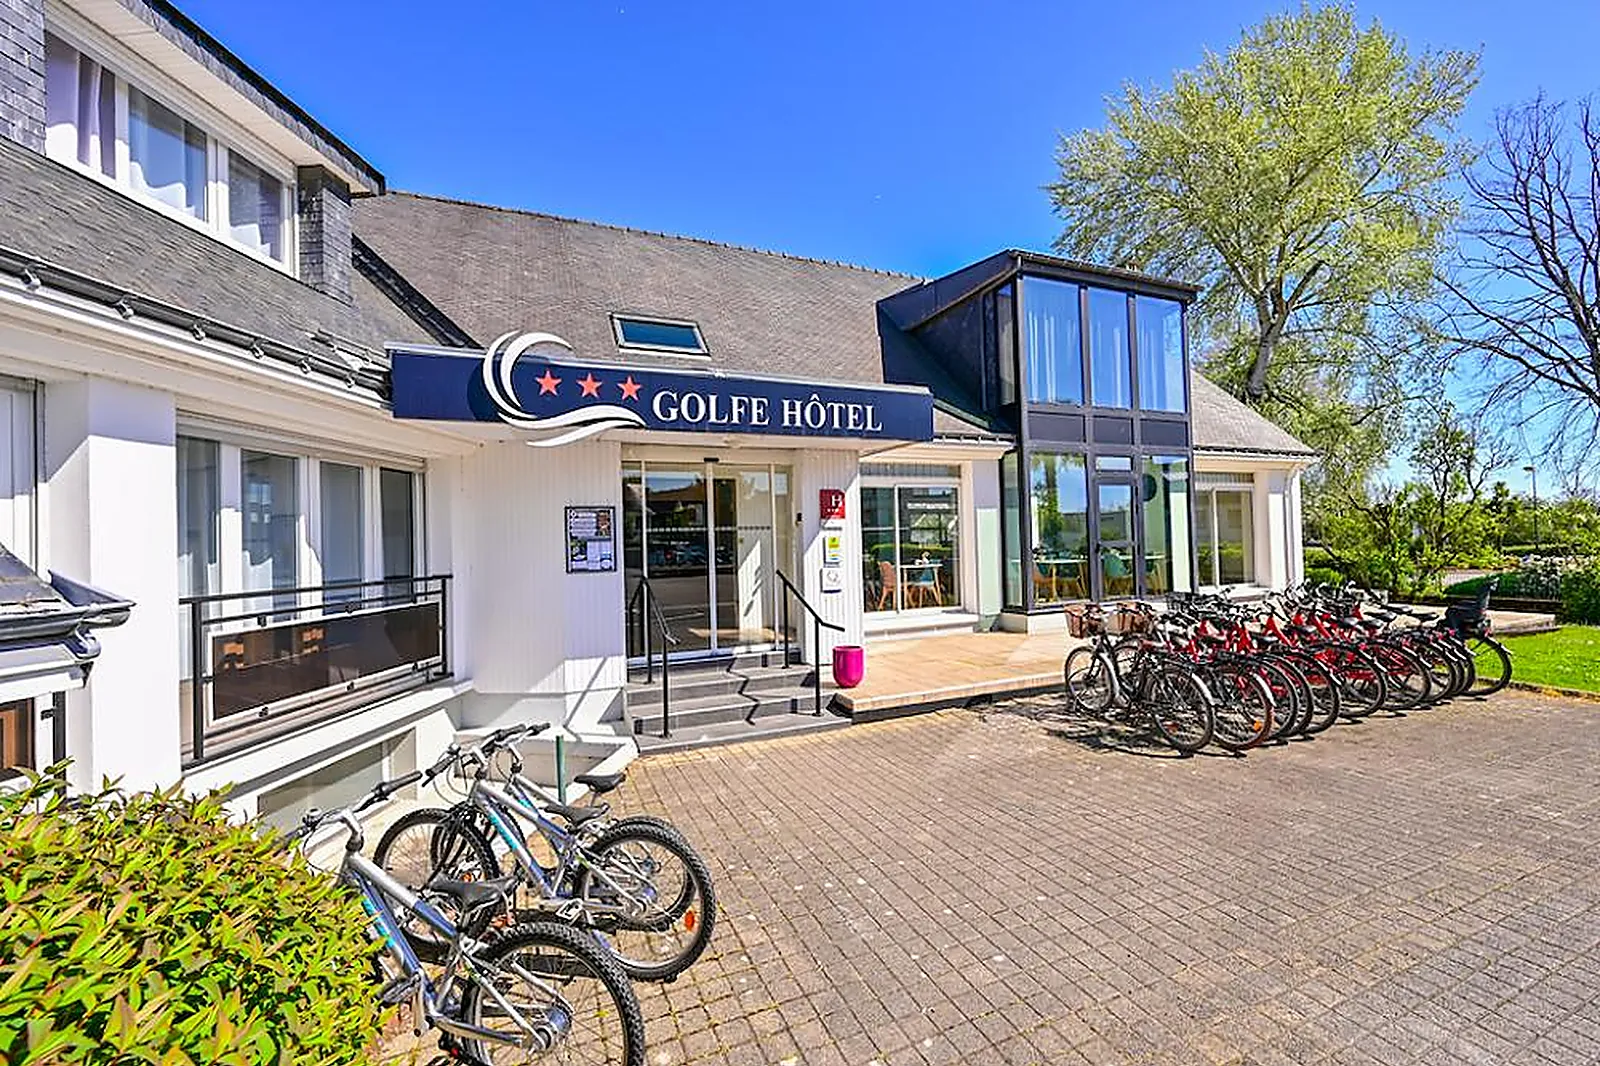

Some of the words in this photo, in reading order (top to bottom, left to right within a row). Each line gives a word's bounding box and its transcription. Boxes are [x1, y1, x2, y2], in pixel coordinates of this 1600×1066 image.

[652, 390, 770, 425] GOLFE
[781, 393, 883, 431] HÔTEL
[831, 495, 843, 507] H
